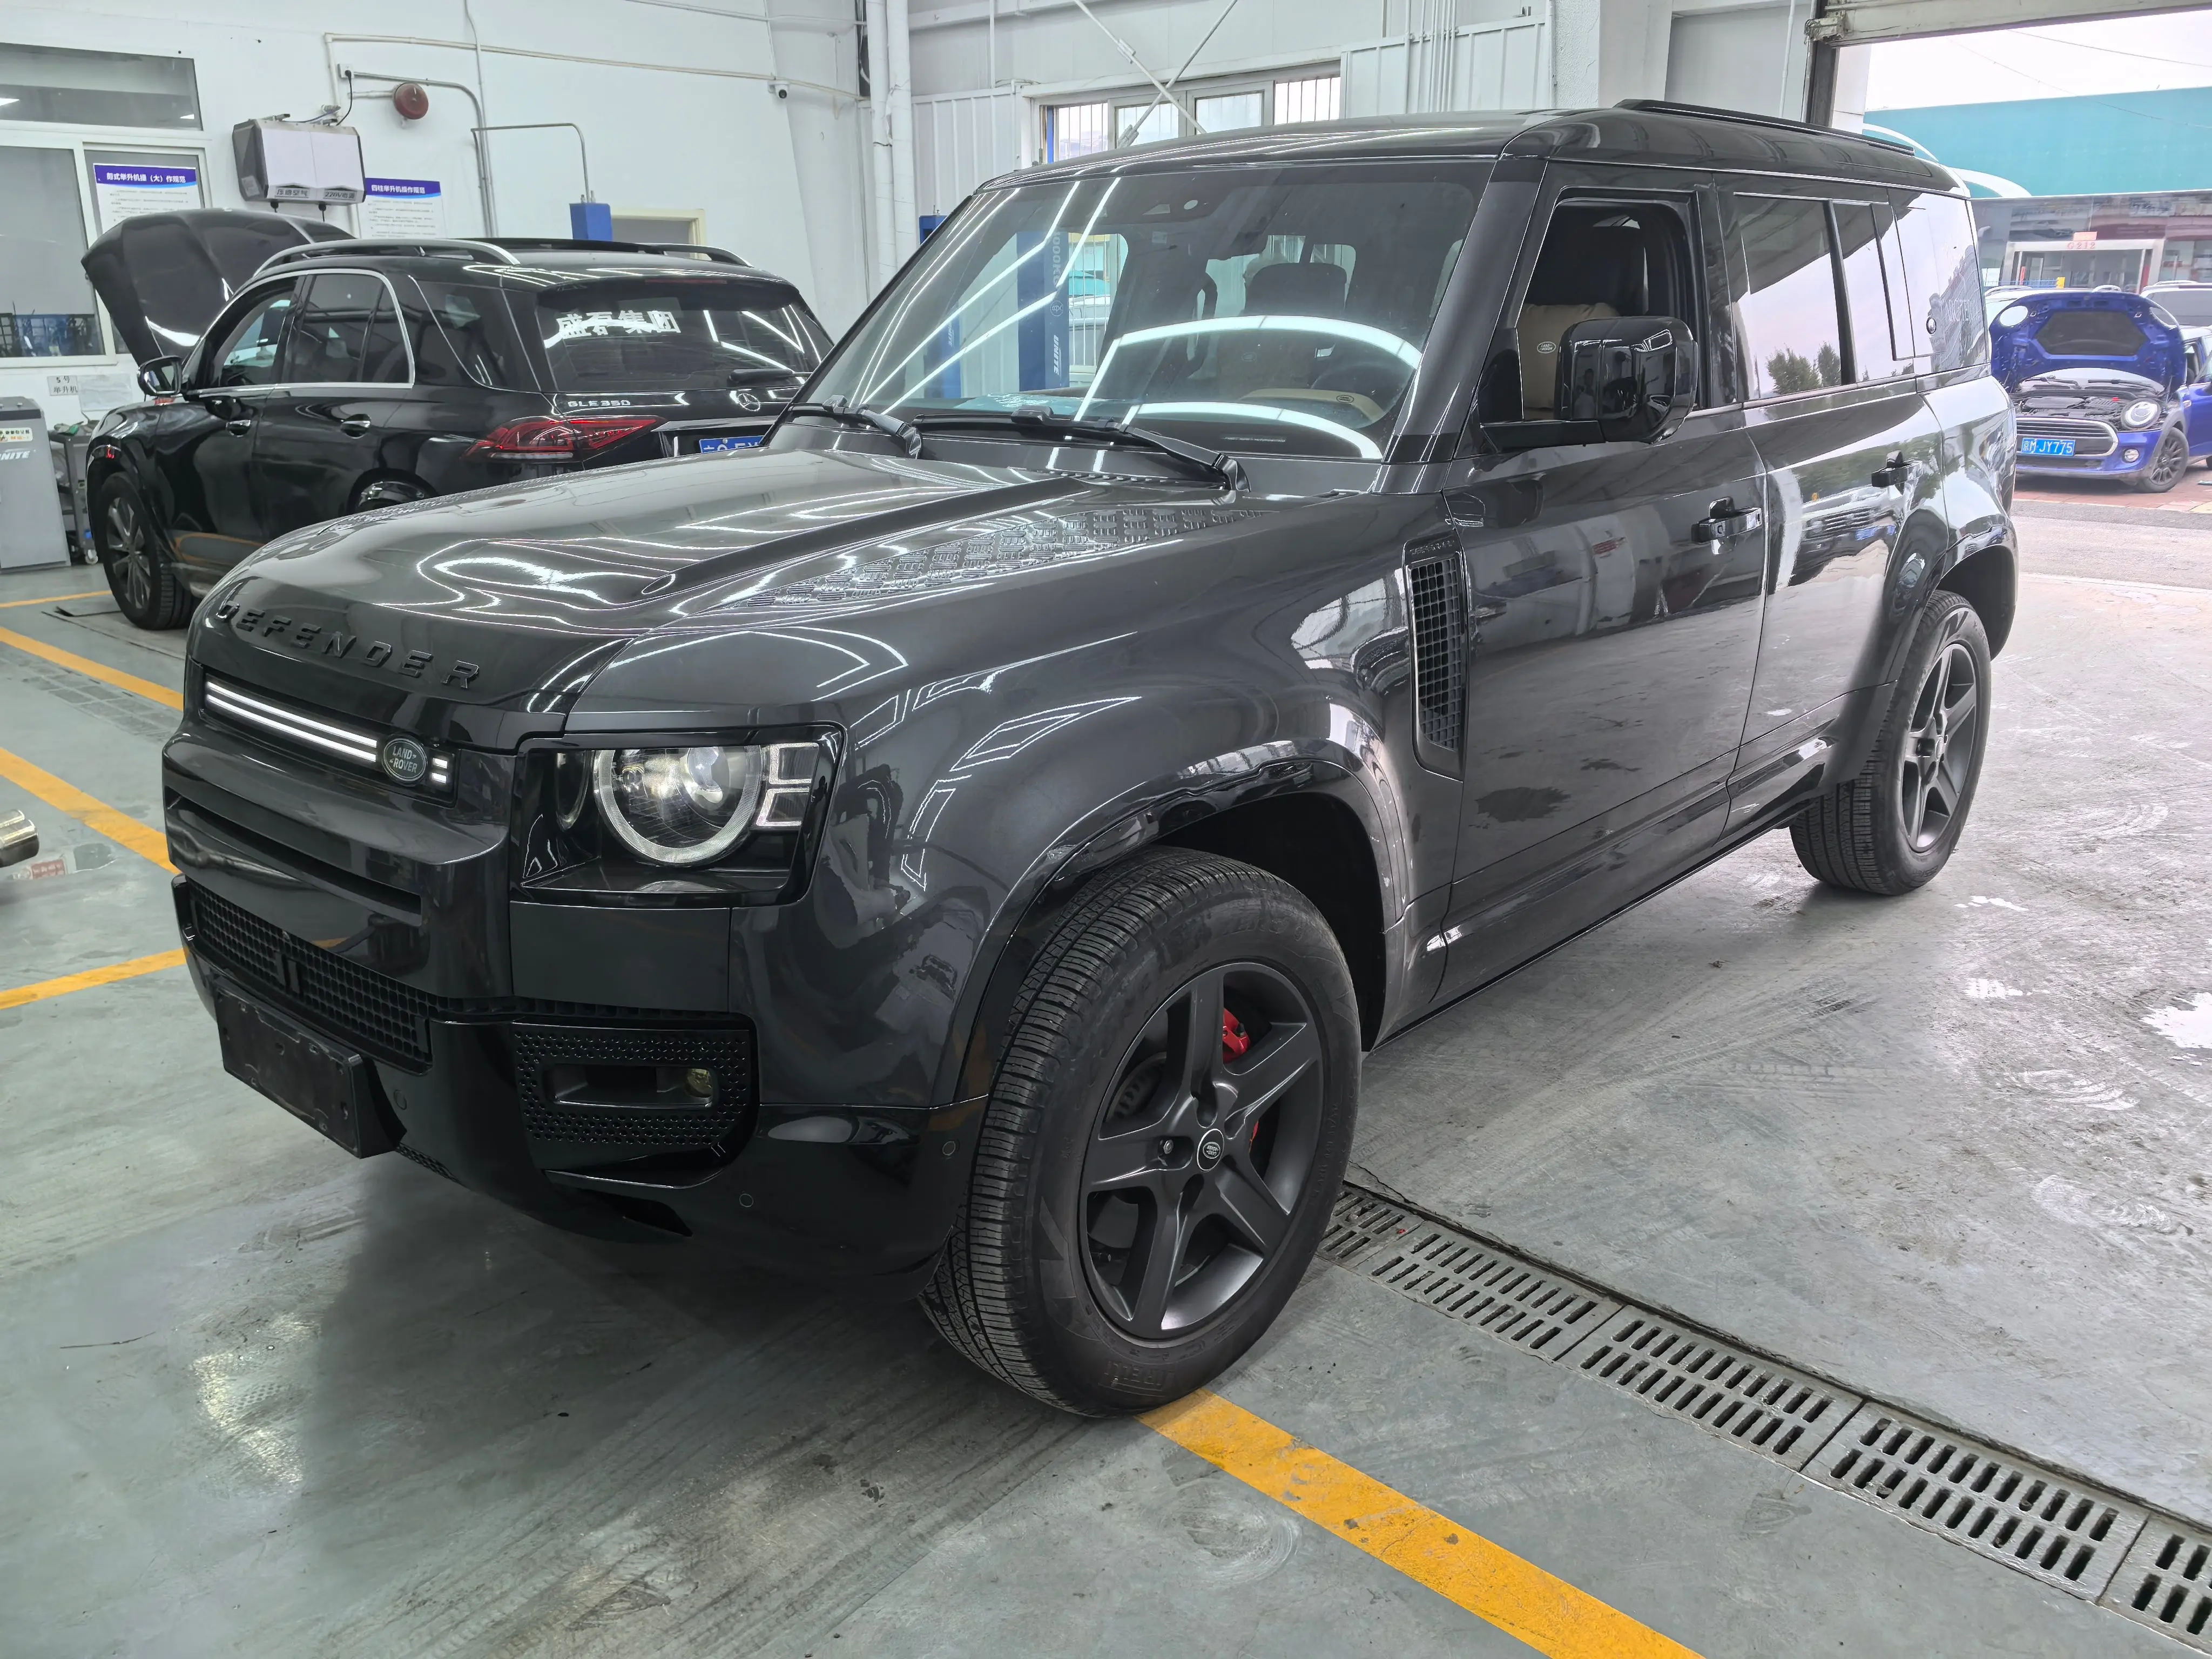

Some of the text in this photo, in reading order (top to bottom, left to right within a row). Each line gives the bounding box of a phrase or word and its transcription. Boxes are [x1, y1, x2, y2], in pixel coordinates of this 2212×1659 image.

[0, 450, 31, 461] NITE
[215, 600, 480, 690] DEFENDER
[393, 746, 412, 760] LAND
[393, 758, 417, 773] ROVER
